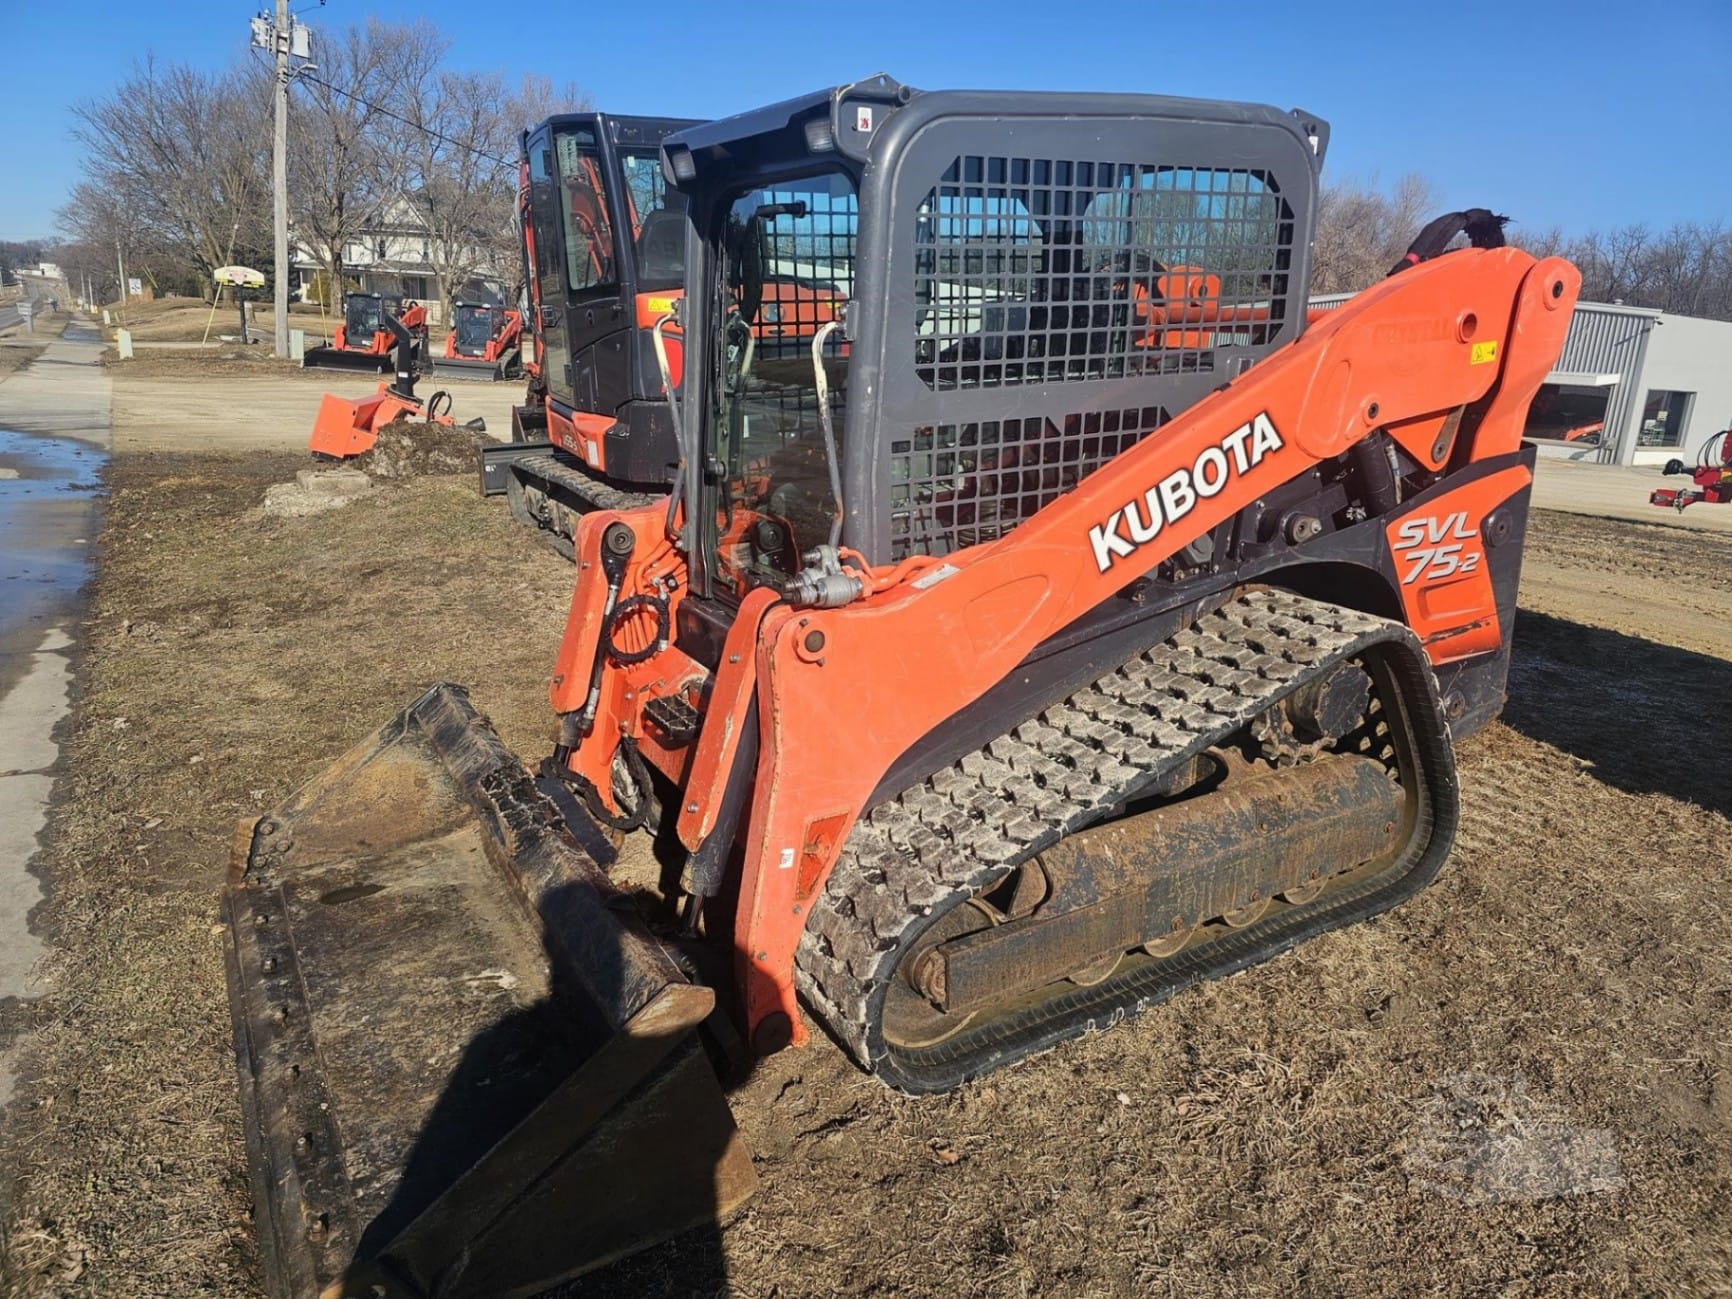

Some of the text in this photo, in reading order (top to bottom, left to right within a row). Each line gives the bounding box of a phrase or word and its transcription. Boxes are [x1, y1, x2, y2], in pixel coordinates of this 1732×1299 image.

[1088, 411, 1284, 573] KUBOTA
[1393, 511, 1479, 550] SVL
[1403, 543, 1481, 585] 75-2
